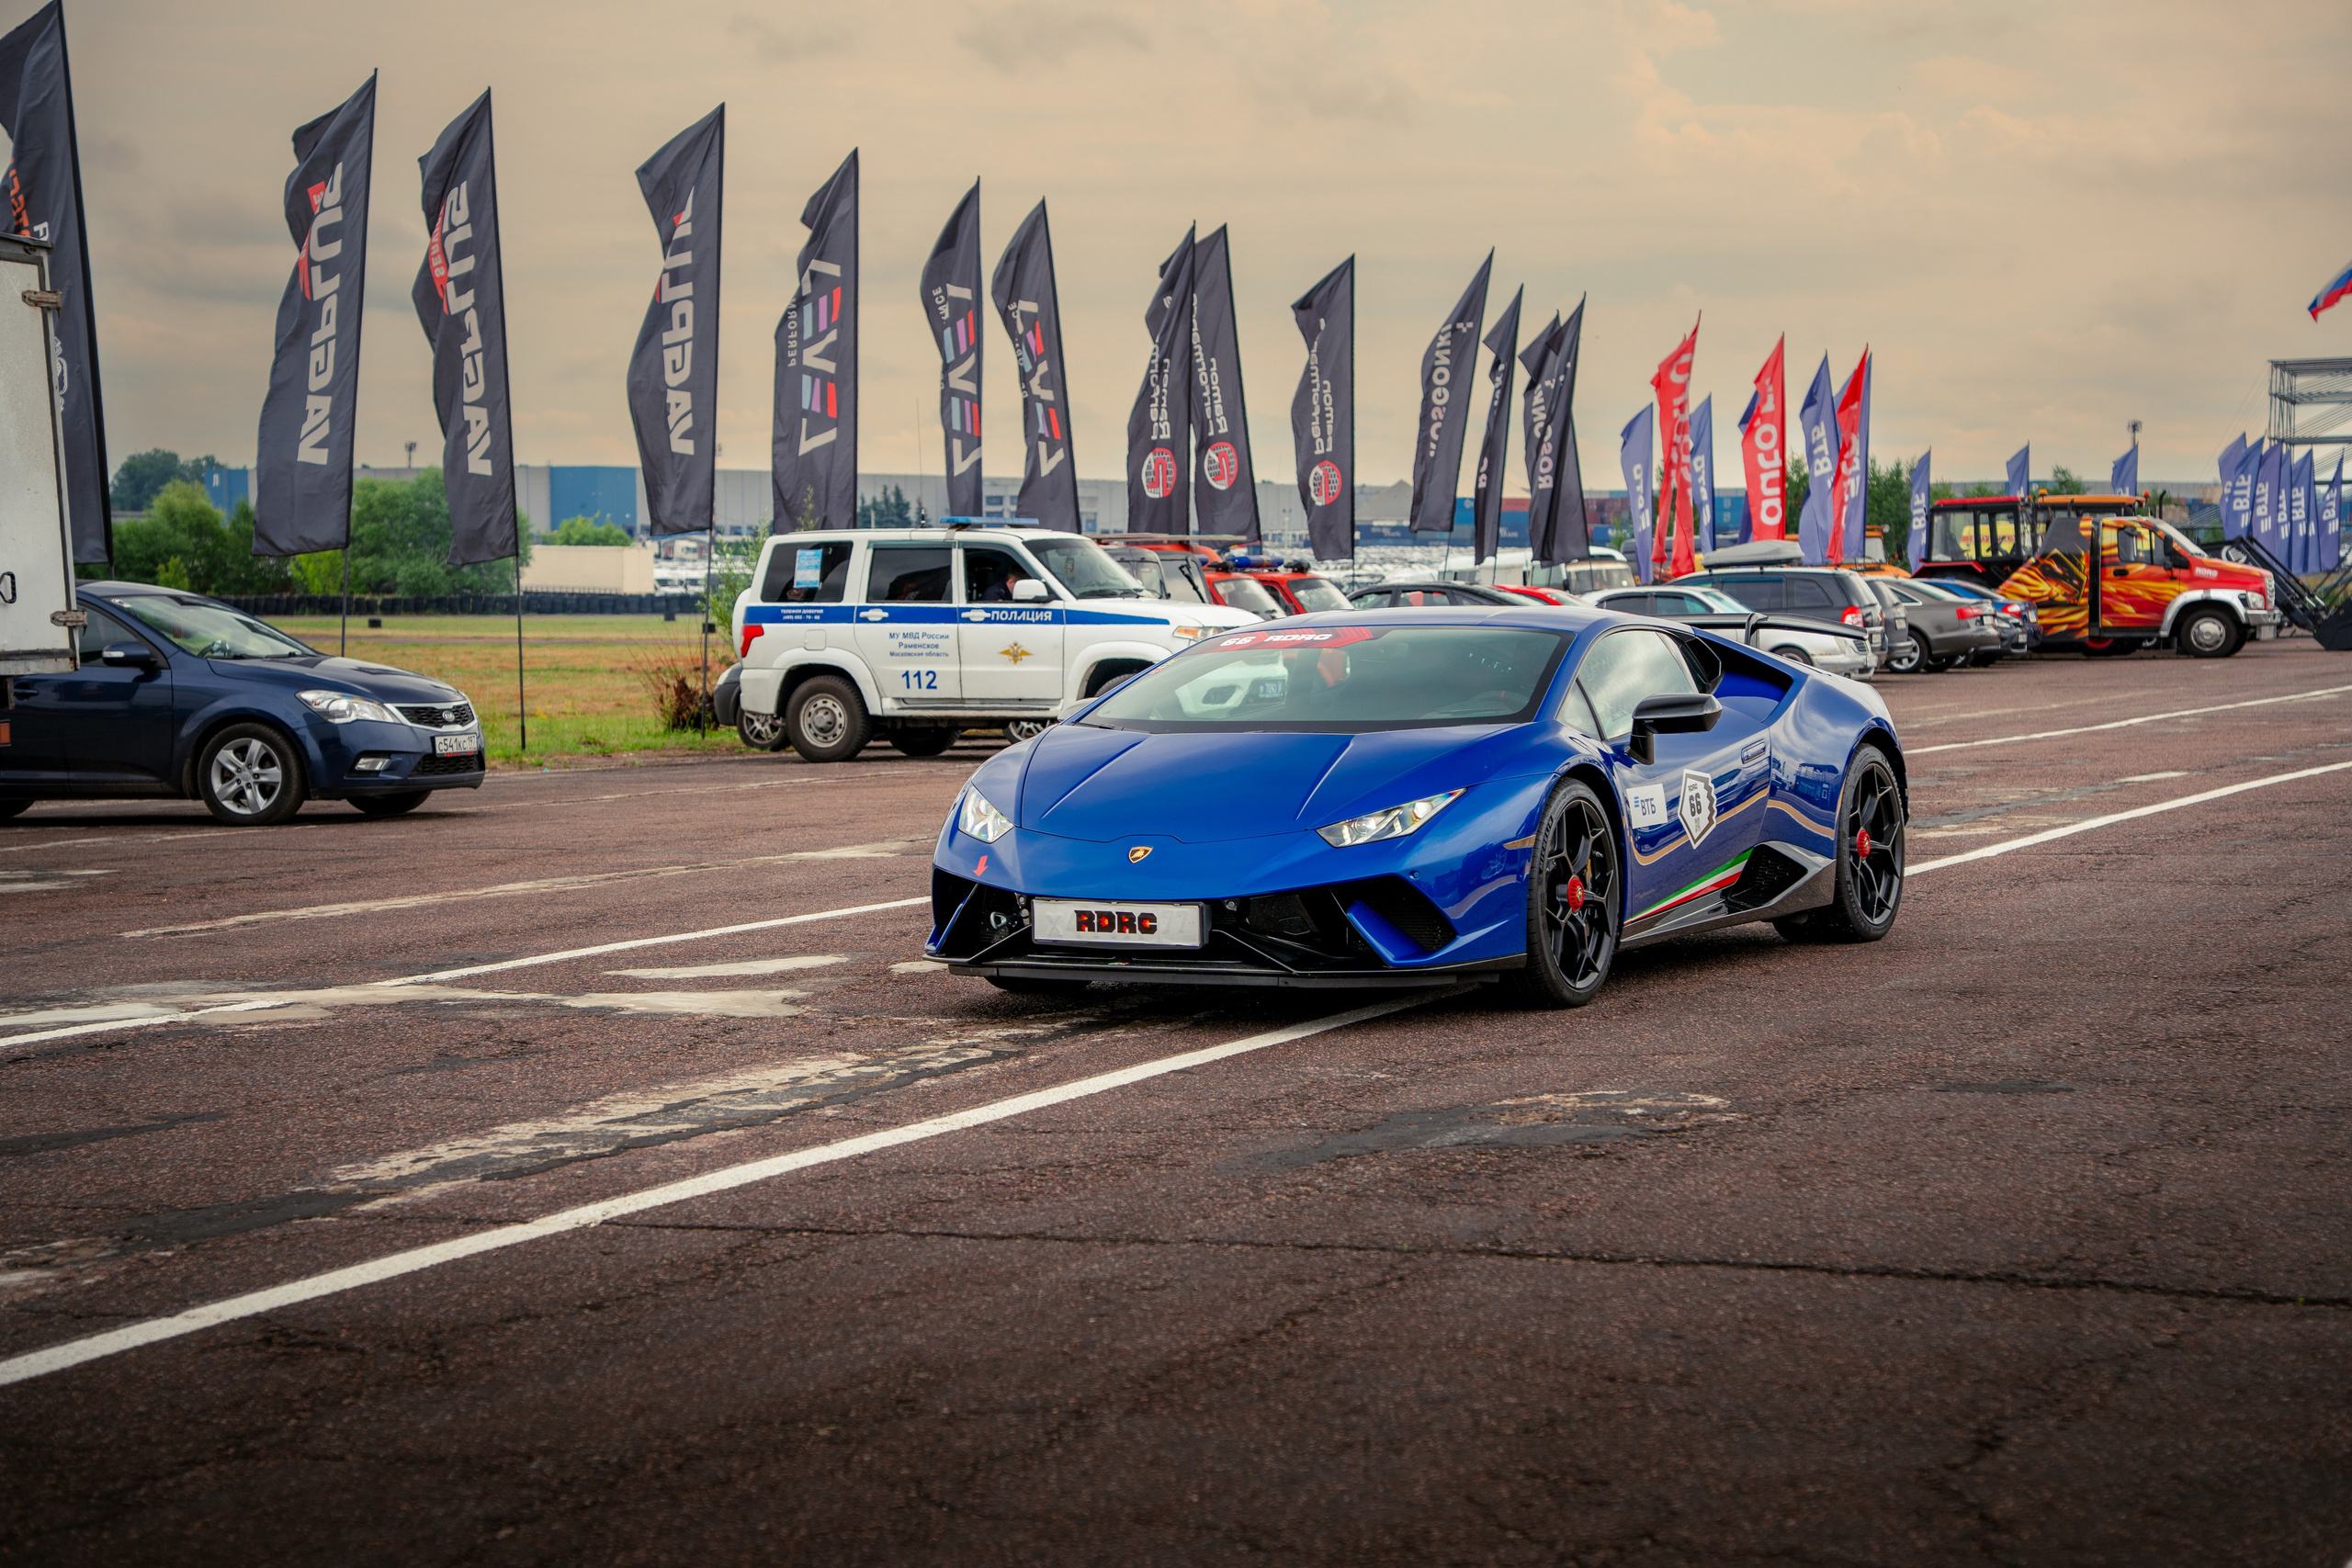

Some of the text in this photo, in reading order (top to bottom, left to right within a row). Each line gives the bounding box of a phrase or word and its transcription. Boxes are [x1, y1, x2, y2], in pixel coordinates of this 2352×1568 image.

[990, 610, 1052, 622] ПОЛИЦИЯ
[888, 632, 950, 640] МУ МВД России
[1219, 636, 1254, 647] 66
[898, 641, 940, 649] Раменское
[901, 670, 938, 690] 112
[1640, 797, 1657, 816] ВТБ
[1689, 793, 1702, 817] 66
[1074, 909, 1158, 935] RDRC
